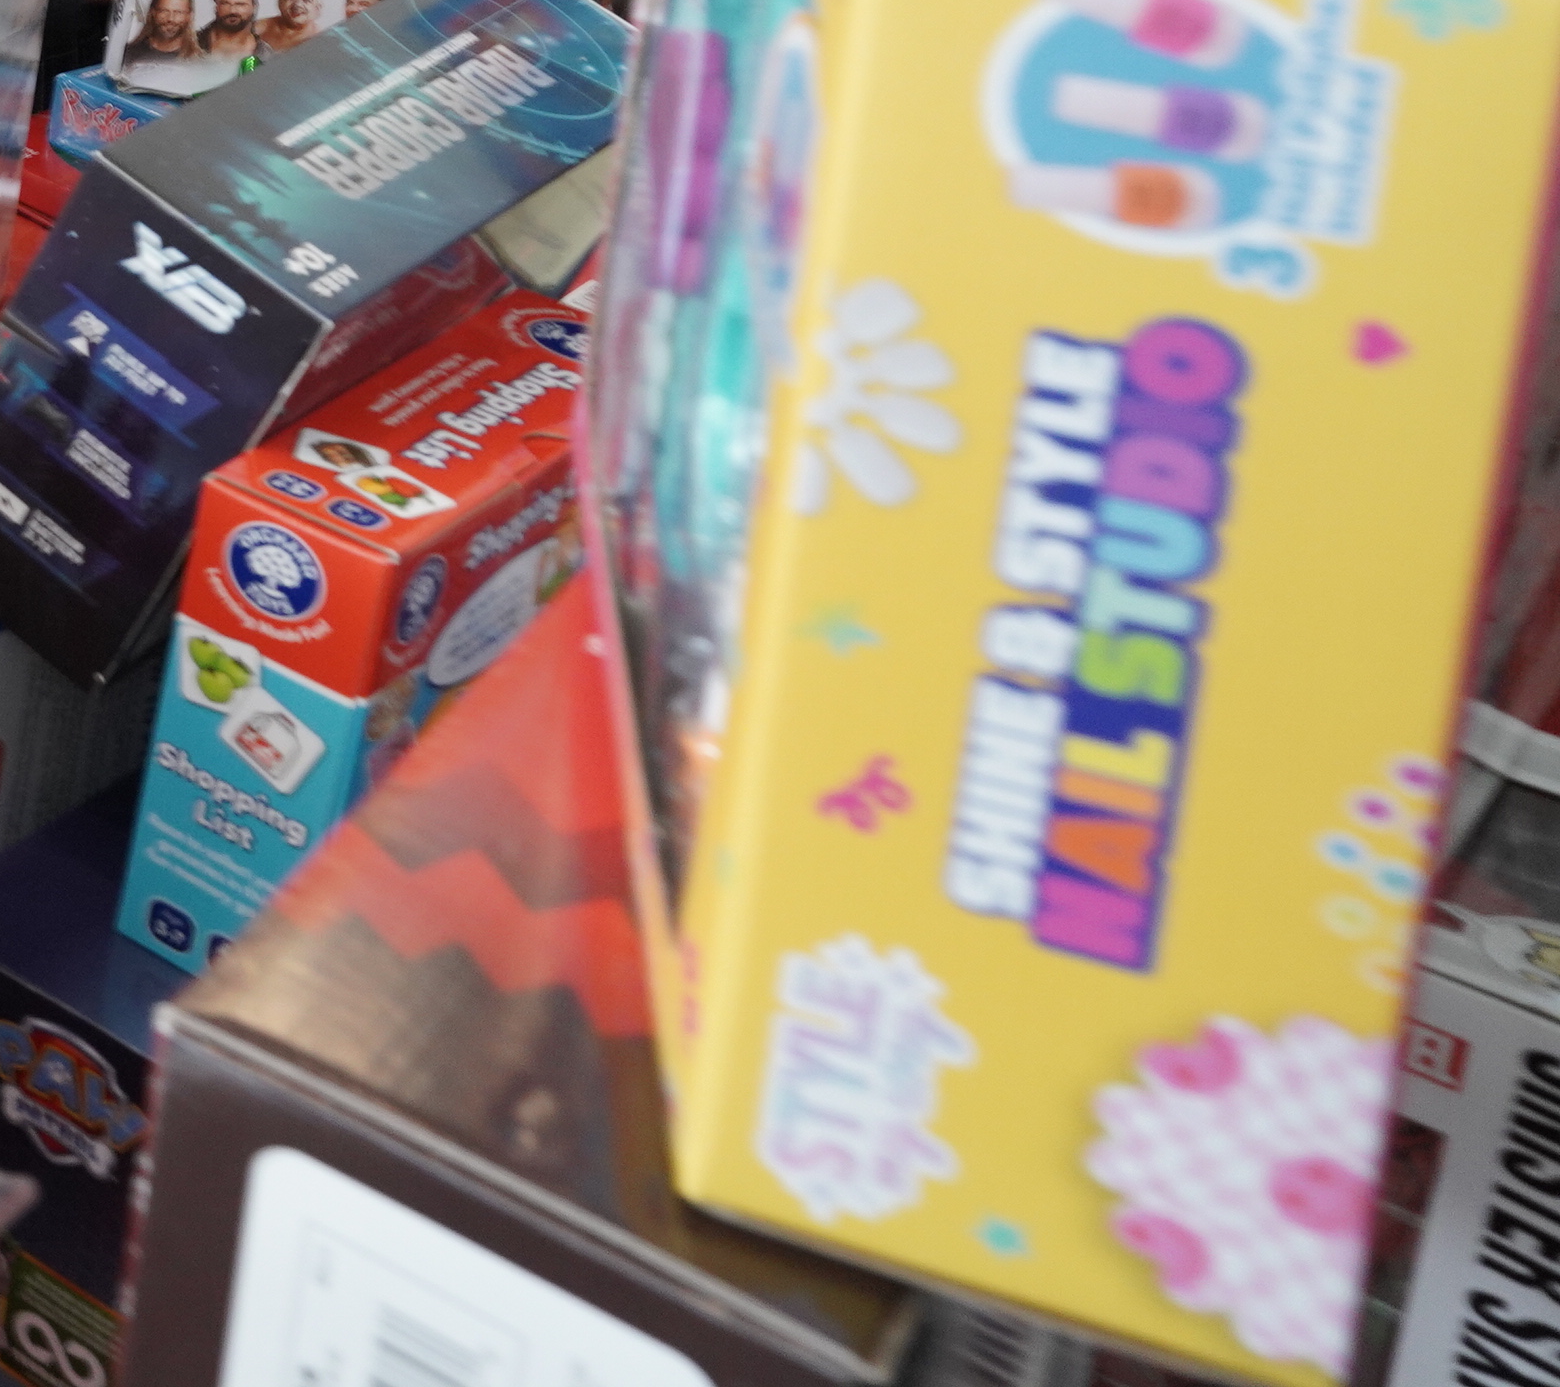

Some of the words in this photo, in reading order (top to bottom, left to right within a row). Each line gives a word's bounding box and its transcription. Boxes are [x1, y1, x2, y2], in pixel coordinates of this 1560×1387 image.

[419, 43, 558, 126] RADAR
[292, 96, 467, 201] CHOPPER
[281, 240, 336, 276] 10+
[435, 361, 584, 438] Shopping
[400, 428, 483, 470] List
[991, 326, 1124, 603] STYLE
[237, 525, 320, 579] ORCHARD
[1064, 318, 1251, 708] STUDIO
[155, 740, 309, 849] Shopping
[192, 798, 255, 852] List
[943, 671, 1066, 925] SHINE
[1031, 726, 1176, 973] NAIL
